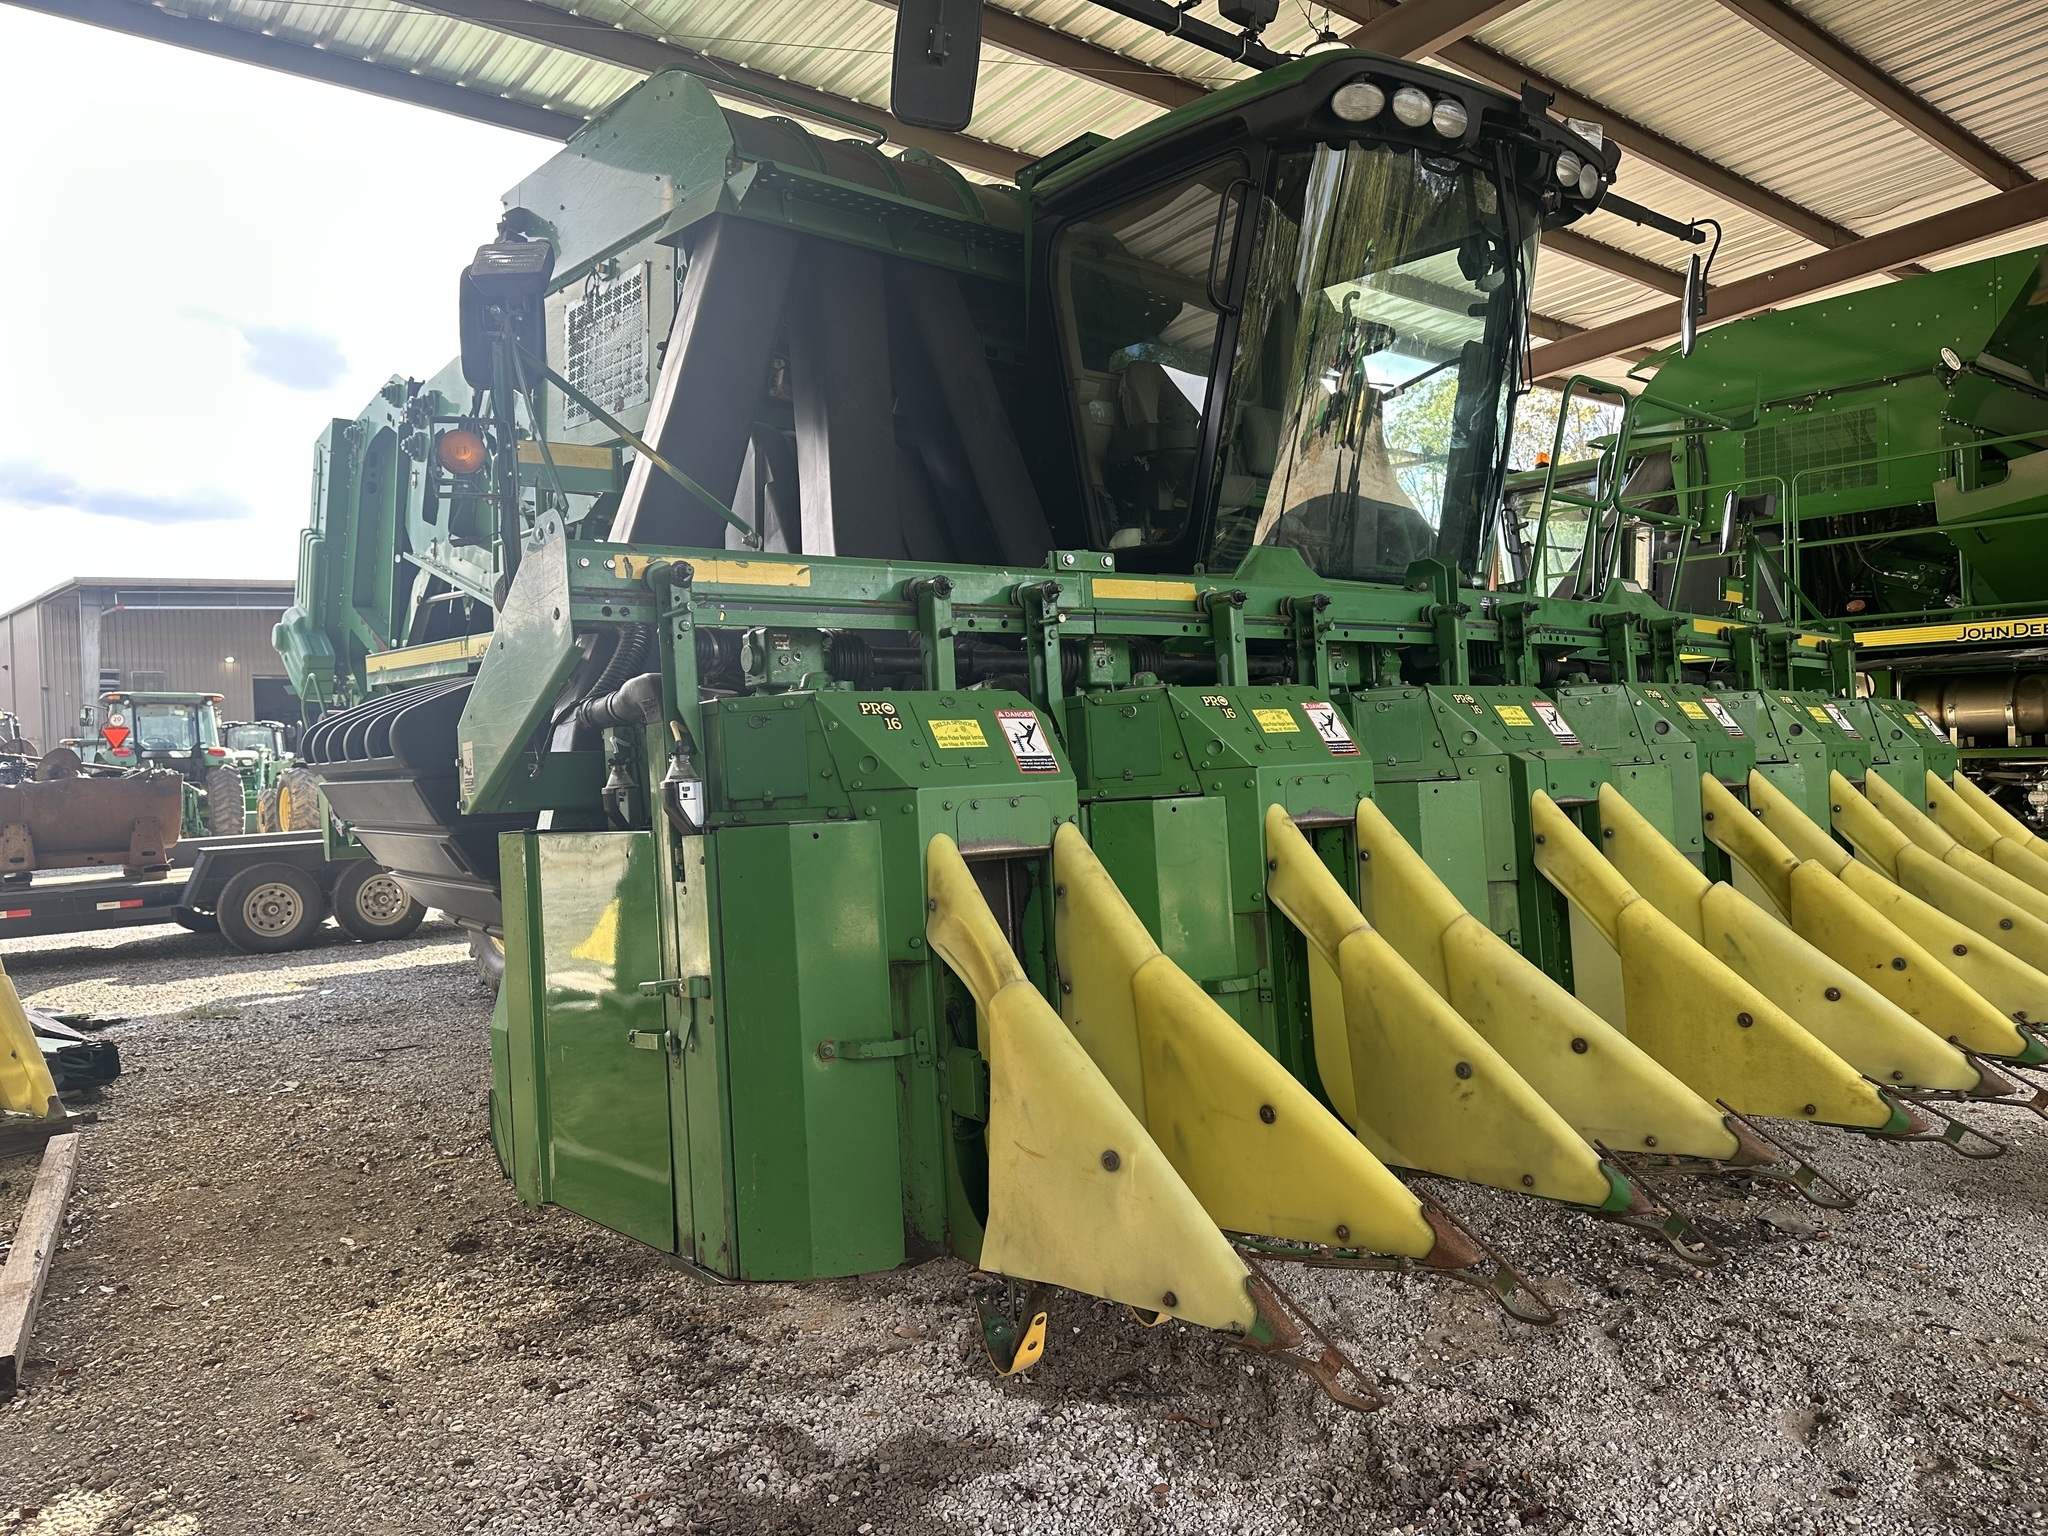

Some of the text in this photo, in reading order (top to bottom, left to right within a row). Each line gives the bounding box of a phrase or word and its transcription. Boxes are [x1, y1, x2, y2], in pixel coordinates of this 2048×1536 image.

[1957, 626, 2009, 640] JOHN
[1201, 695, 1229, 706] PRO
[1453, 694, 1475, 704] PRO
[859, 702, 896, 715] PRO
[1222, 708, 1237, 719] 16
[1471, 705, 1483, 715] 16
[884, 717, 902, 730] 16
[932, 720, 952, 730] DELTA
